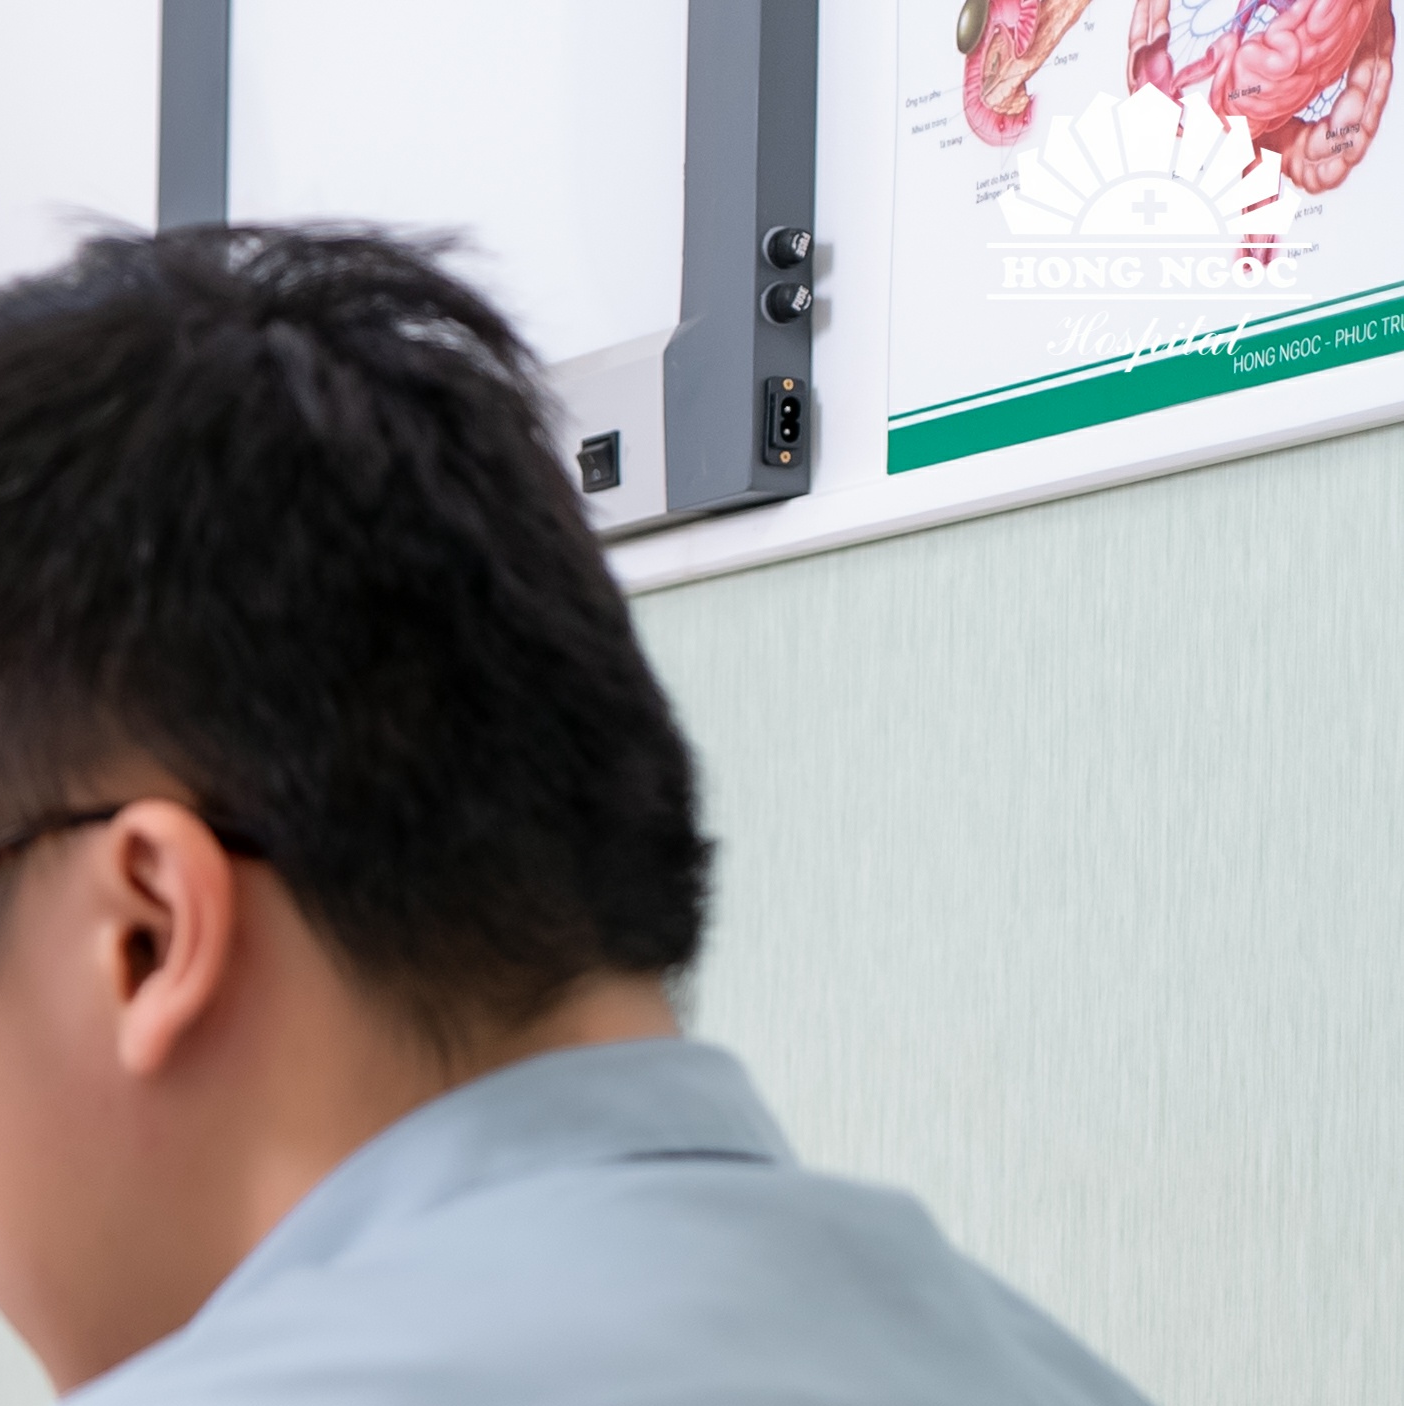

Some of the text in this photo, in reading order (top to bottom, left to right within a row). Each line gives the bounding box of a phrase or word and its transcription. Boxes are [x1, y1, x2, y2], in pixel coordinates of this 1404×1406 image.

[791, 285, 809, 311] FUSE
[1234, 346, 1277, 374] HONG
[1279, 334, 1322, 363] NGOC
[1335, 320, 1378, 349] PHUC
